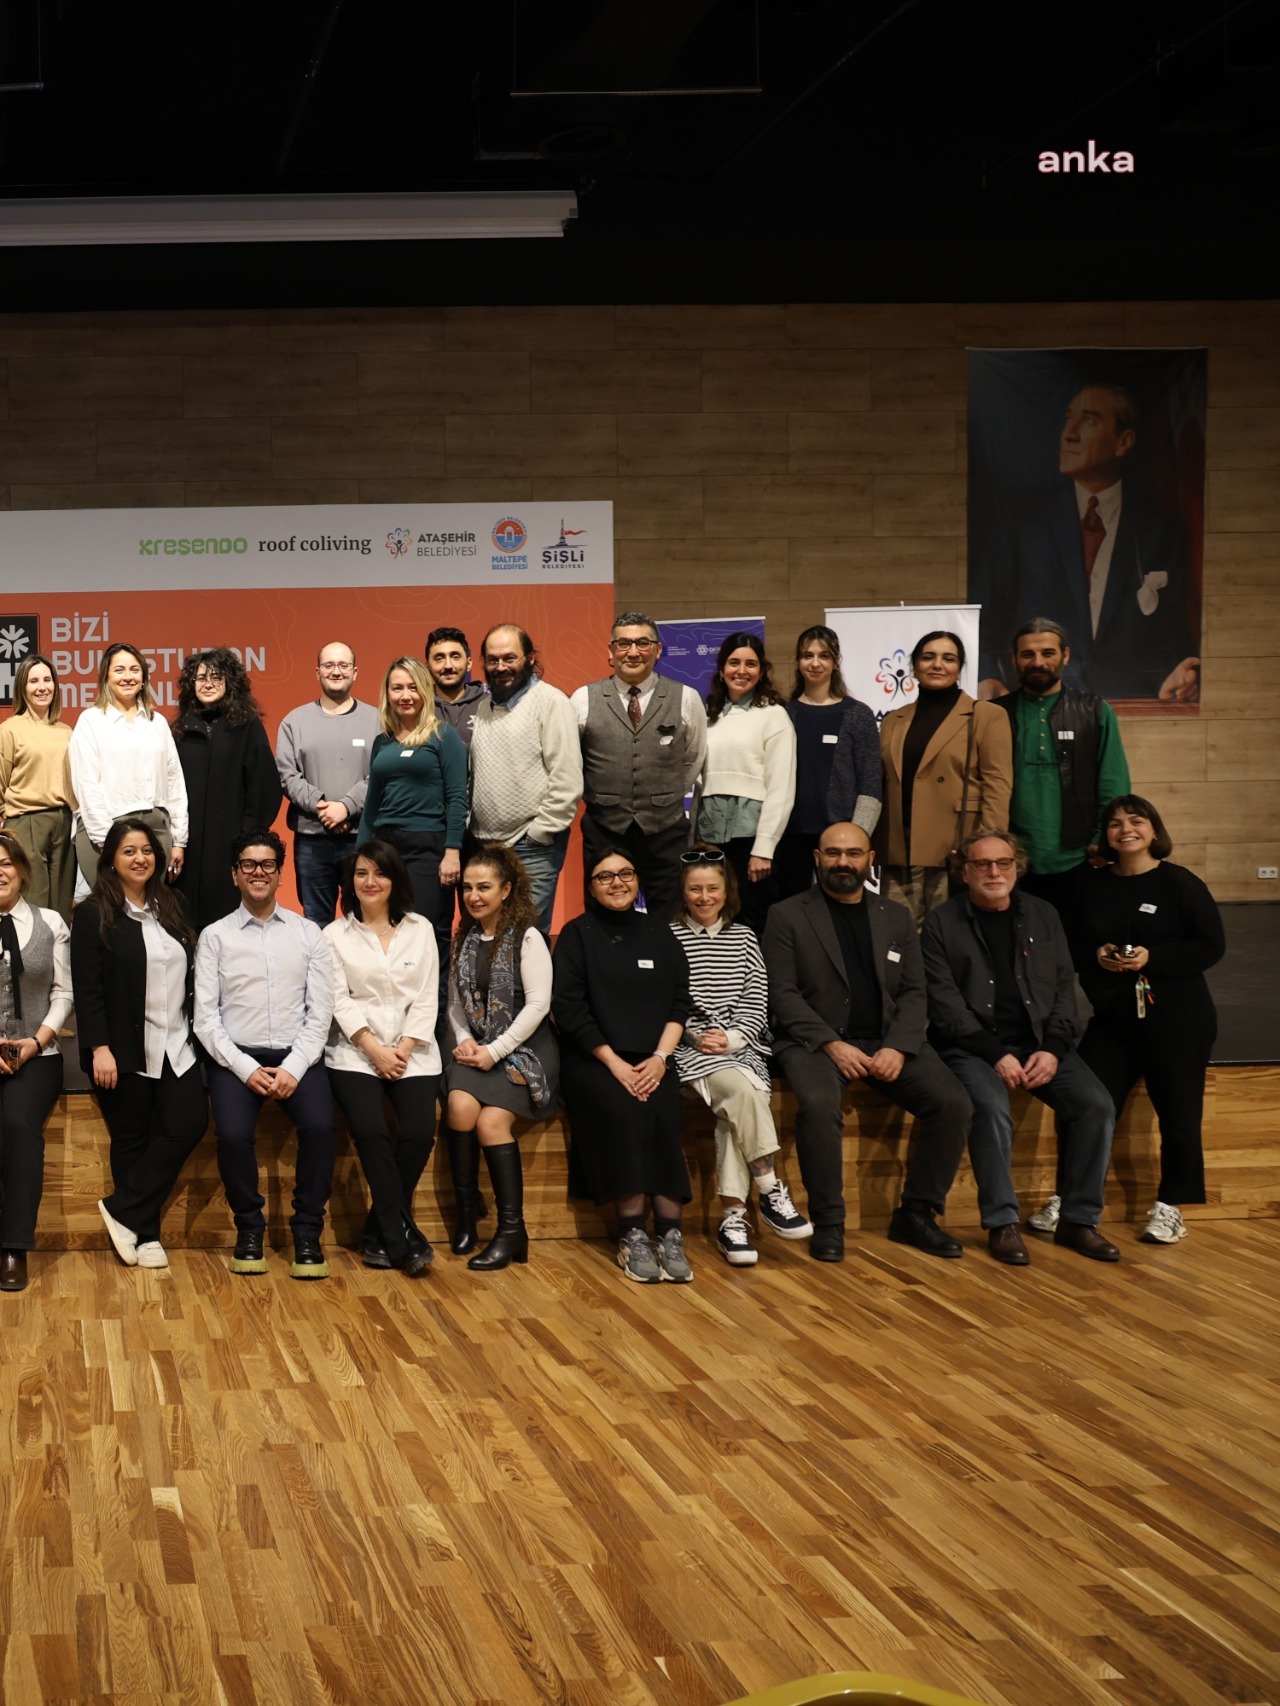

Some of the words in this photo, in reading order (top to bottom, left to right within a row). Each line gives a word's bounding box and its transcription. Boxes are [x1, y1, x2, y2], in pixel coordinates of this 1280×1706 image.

[259, 536, 296, 552] roof
[300, 535, 372, 555] coliving
[417, 531, 476, 545] ATAŞEHİR
[417, 545, 477, 556] BELEDİYESİ
[542, 550, 584, 564] ŞİŞLİ
[491, 555, 528, 563] MALTEPE
[52, 611, 109, 643] BİZİ
